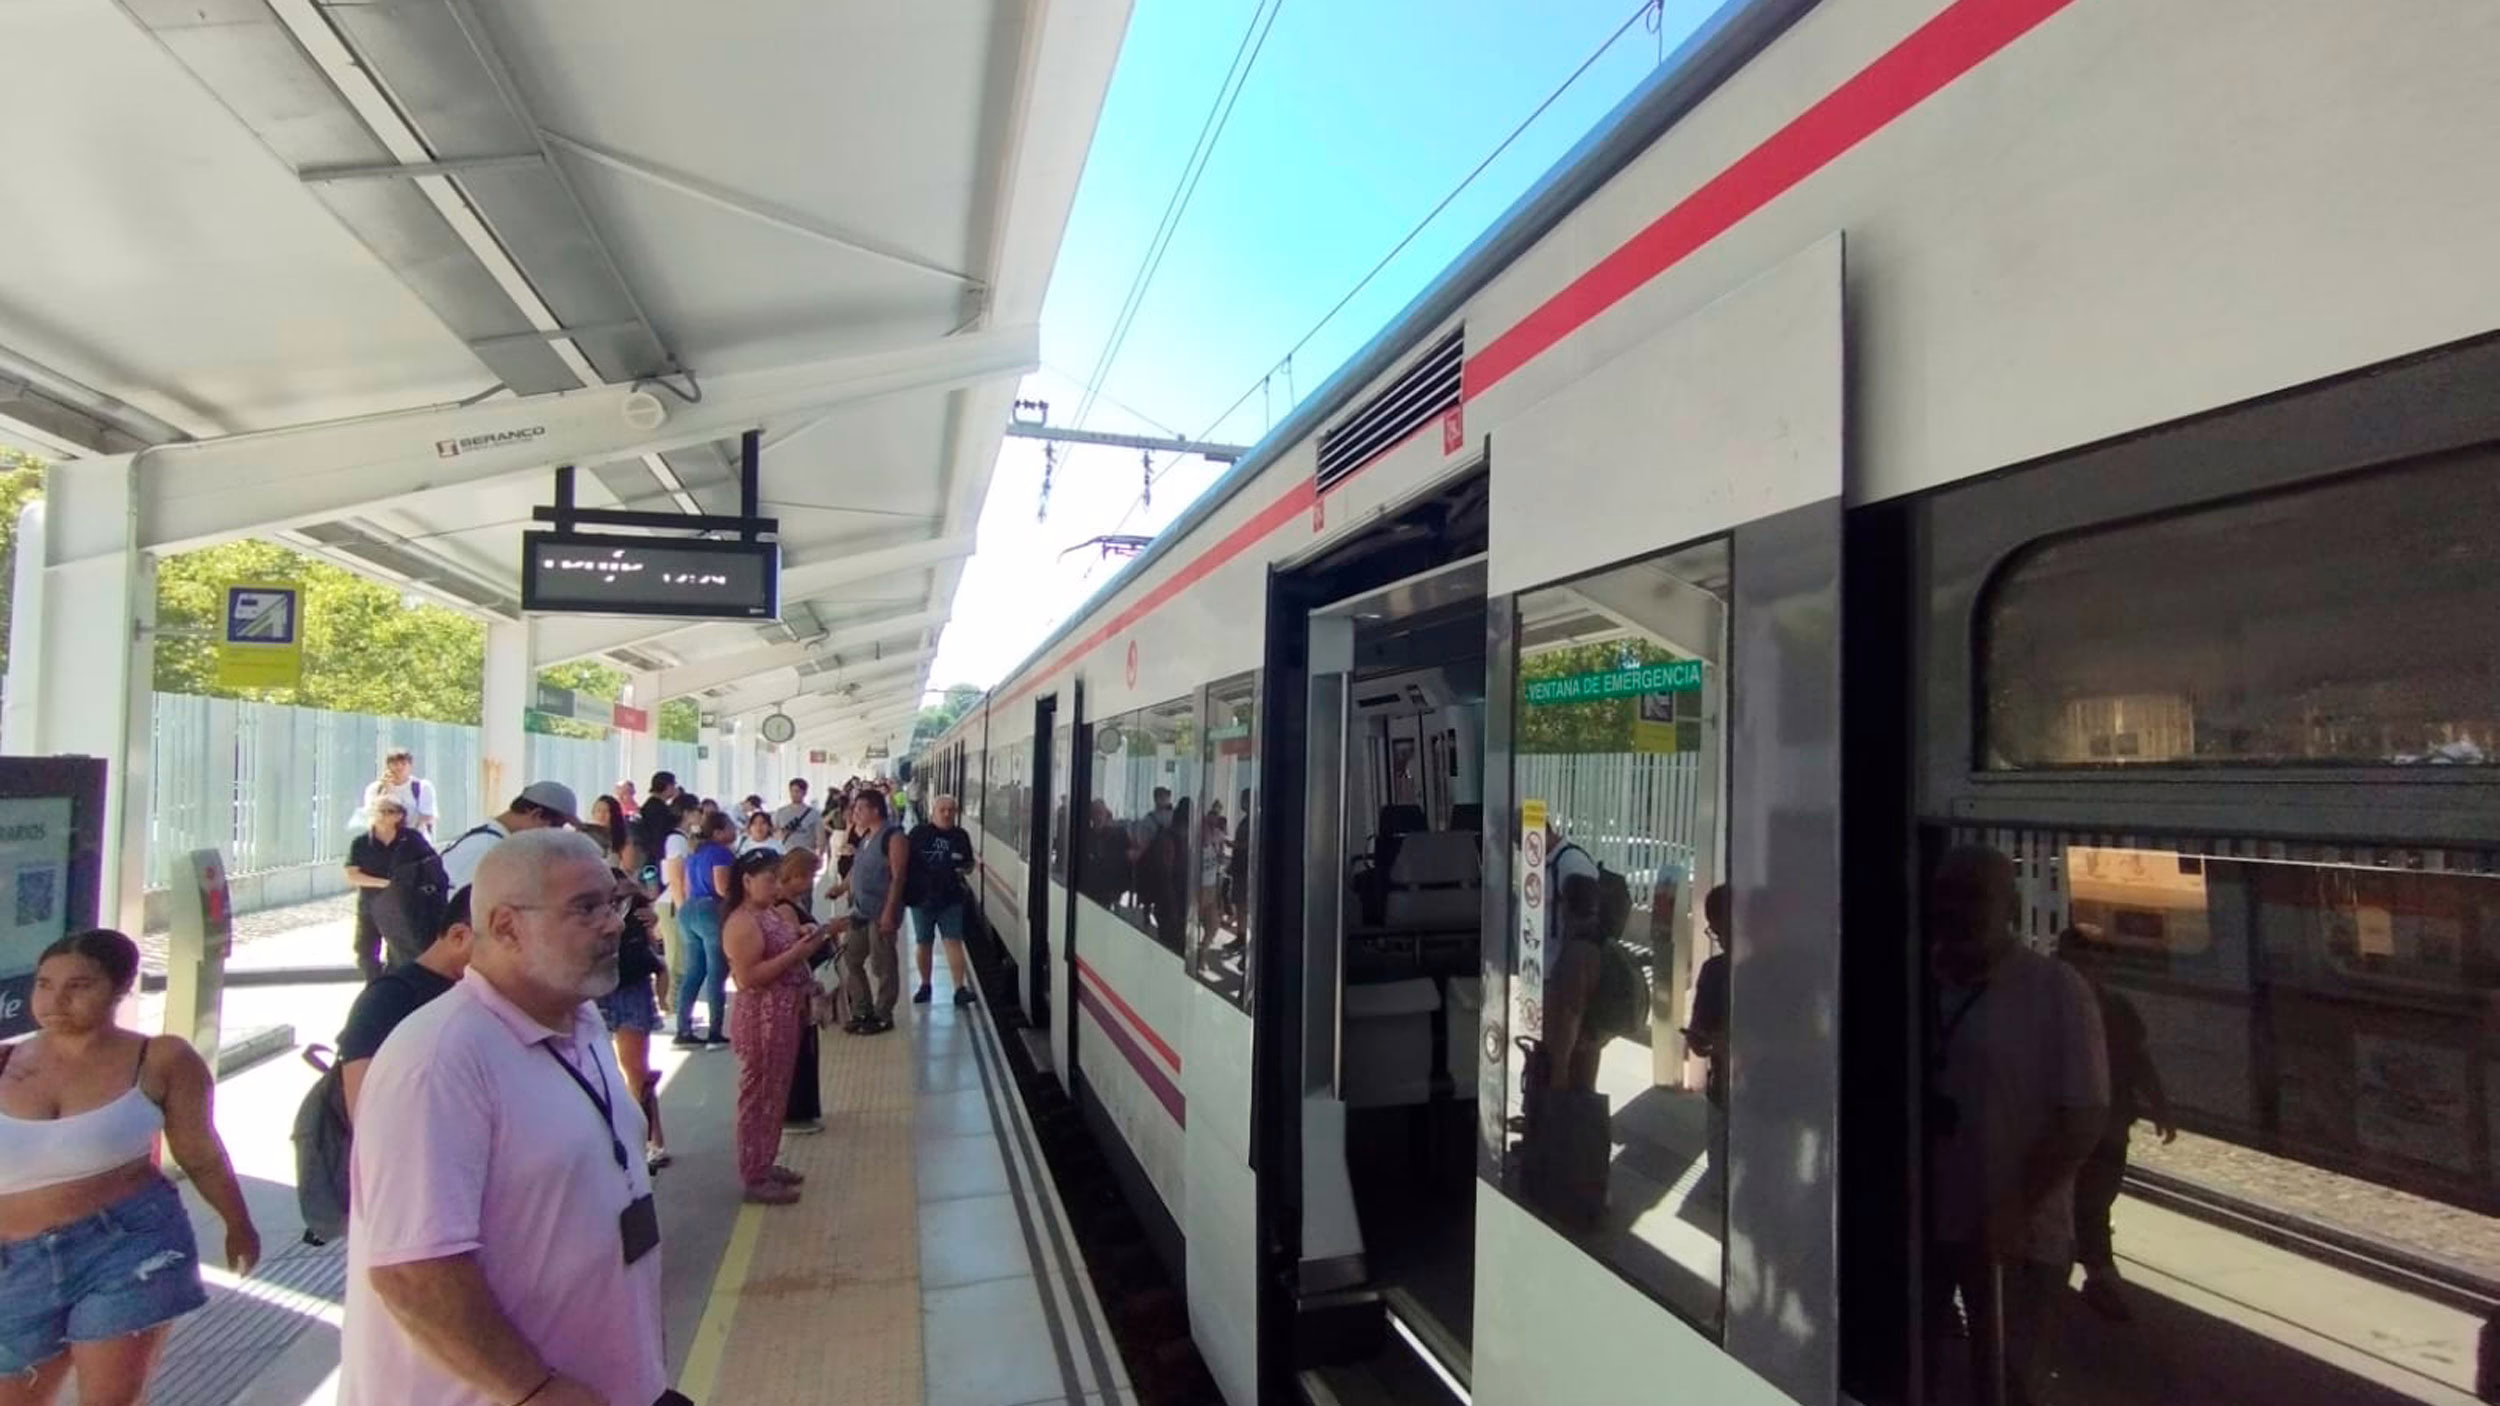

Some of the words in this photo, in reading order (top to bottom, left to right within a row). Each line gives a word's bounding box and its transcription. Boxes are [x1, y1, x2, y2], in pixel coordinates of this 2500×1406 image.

[460, 426, 545, 447] SERANCO
[1529, 678, 1580, 700] VENTANA
[1583, 676, 1601, 694] DE
[1603, 664, 1701, 693] EMERGENCIA
